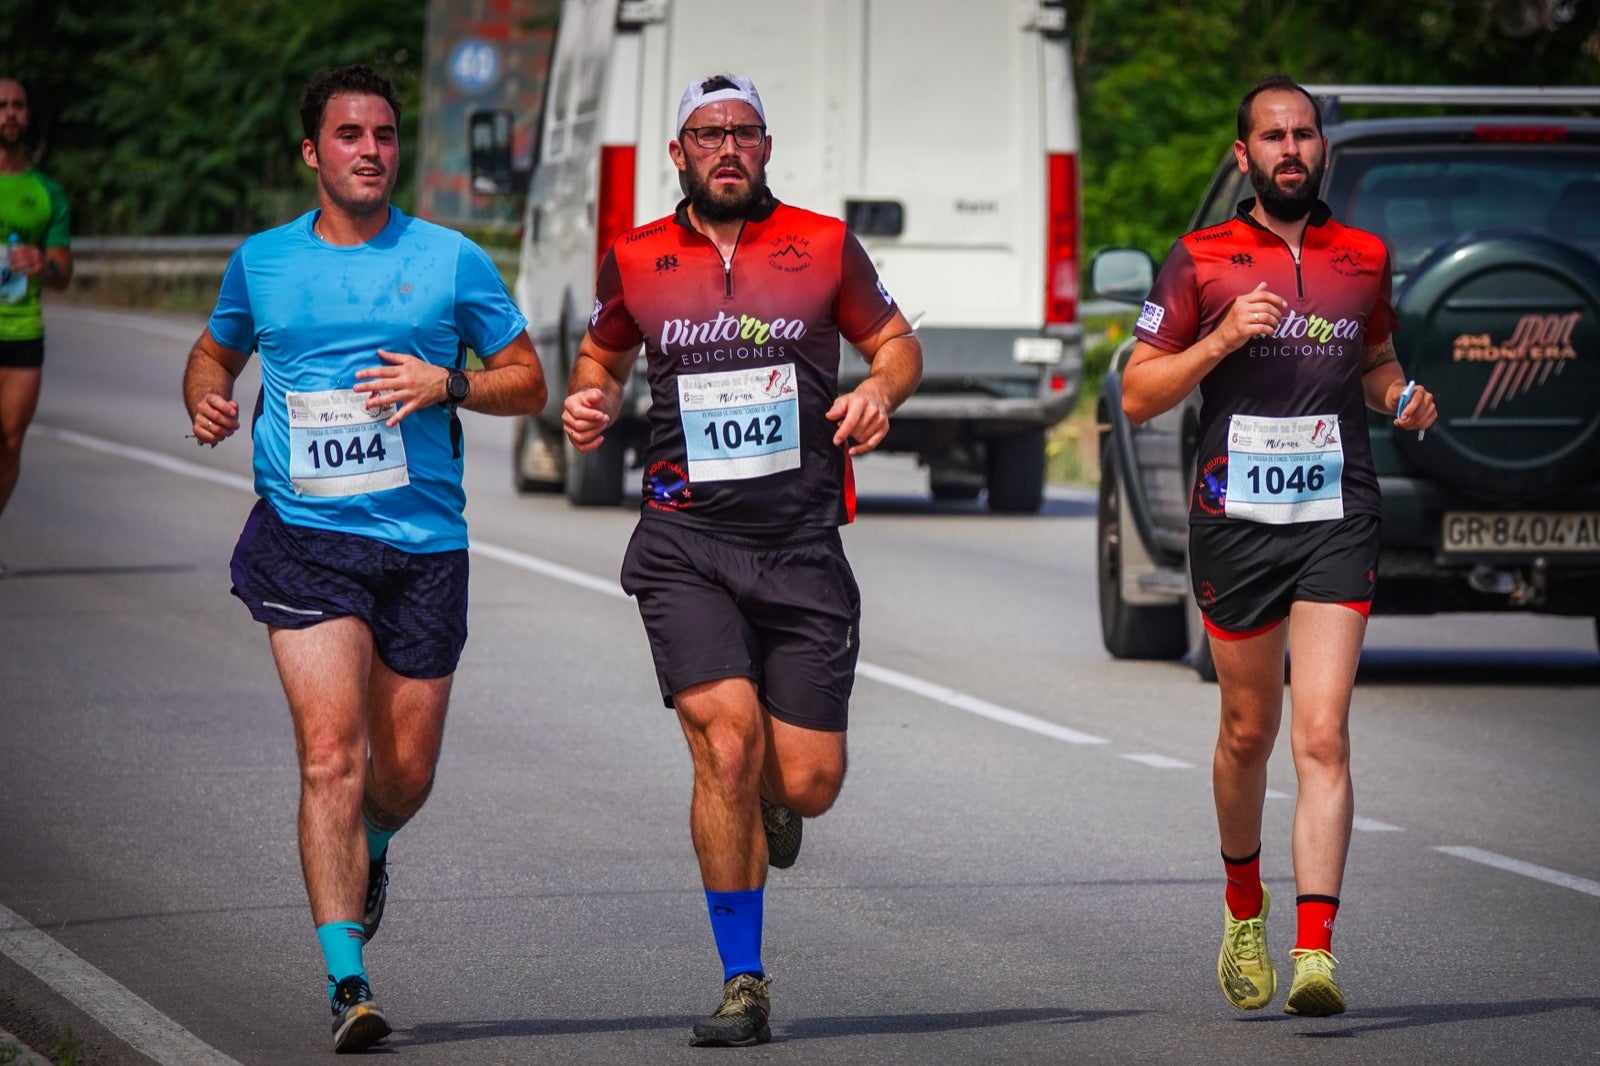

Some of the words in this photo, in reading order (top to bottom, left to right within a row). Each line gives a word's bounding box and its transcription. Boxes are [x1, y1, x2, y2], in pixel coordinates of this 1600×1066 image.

[626, 225, 667, 245] JUANMI
[1252, 310, 1359, 343] torrea
[681, 346, 785, 365] EDICIONES
[1249, 345, 1343, 358] EDICIONES
[704, 415, 783, 450] 1042
[308, 433, 386, 469] 1044
[1247, 465, 1325, 495] 1046
